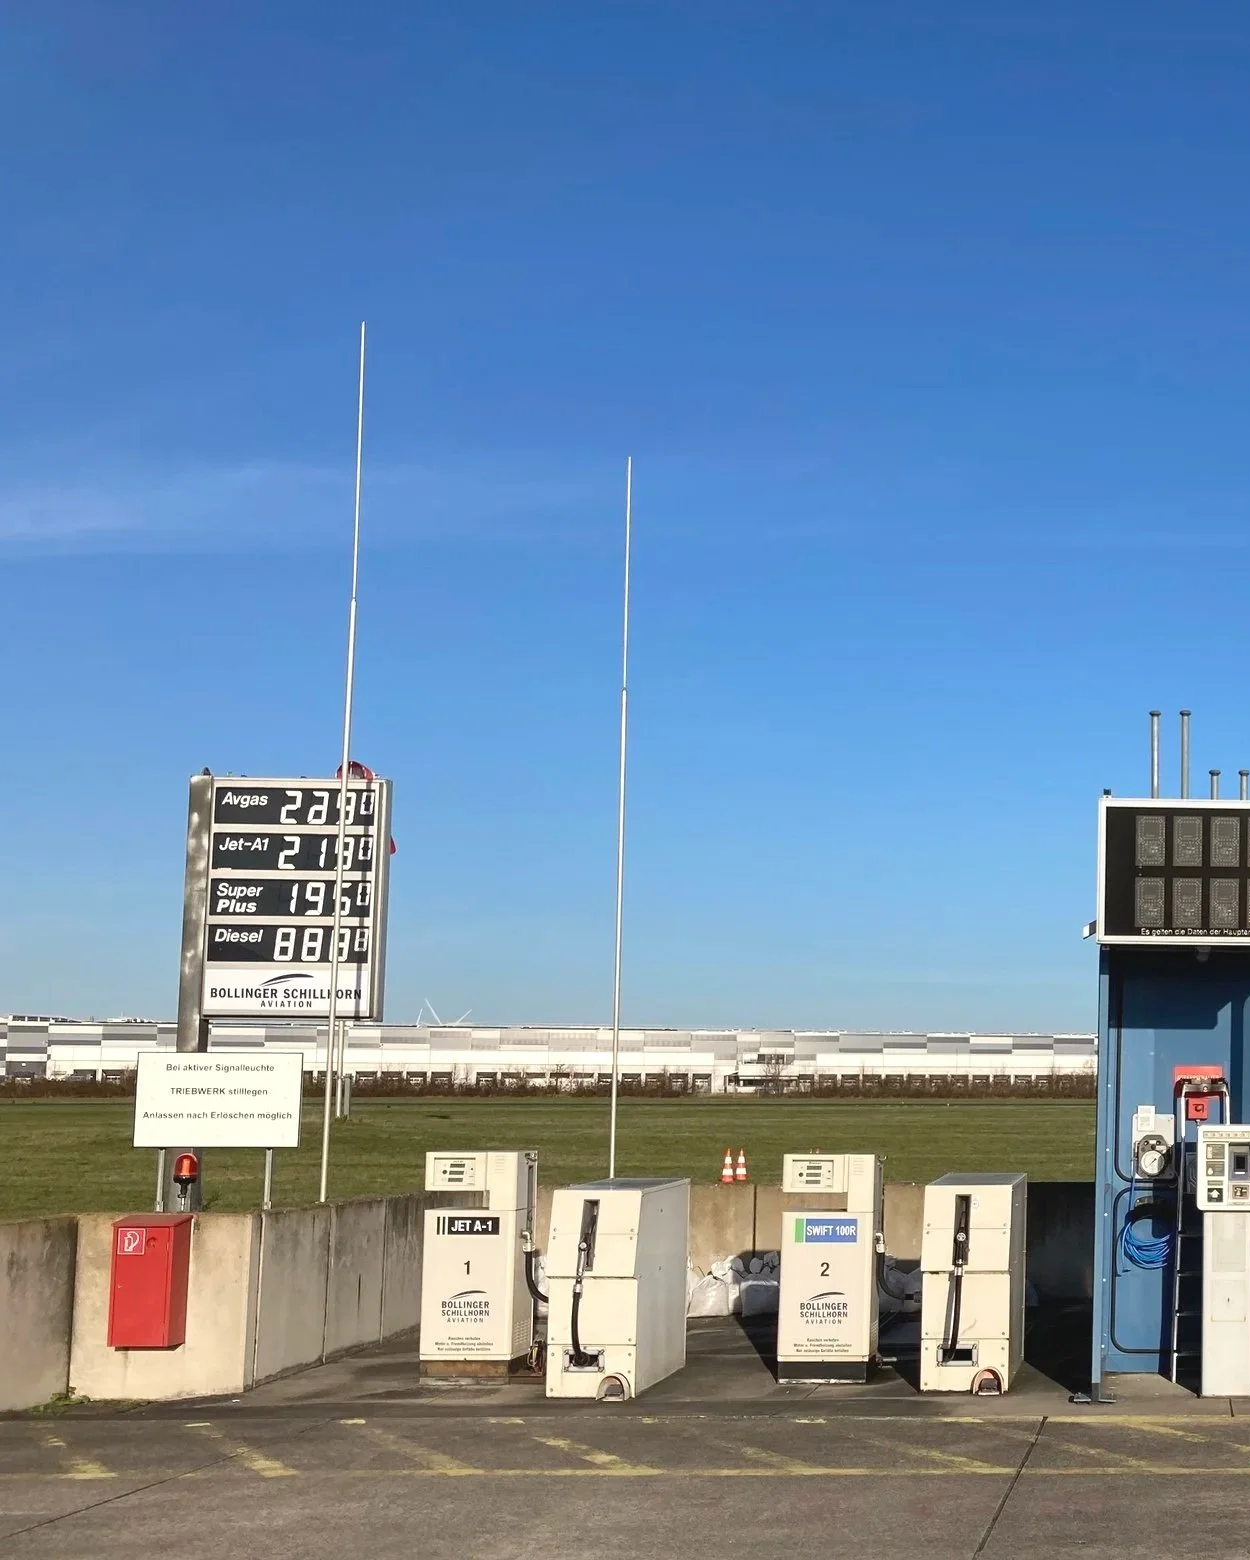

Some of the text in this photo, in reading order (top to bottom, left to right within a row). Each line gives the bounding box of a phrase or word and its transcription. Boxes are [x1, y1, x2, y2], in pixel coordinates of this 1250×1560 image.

[222, 792, 269, 808] Avgas
[219, 838, 270, 851] Jet-A1
[216, 882, 264, 898] Super
[216, 899, 258, 913] Plus
[214, 928, 264, 943] Diesel
[1141, 928, 1150, 936] Es
[1187, 928, 1208, 936] Daten
[1209, 928, 1222, 936] der
[210, 987, 362, 1000] BOLLINGER SCHILLHORN
[260, 1000, 312, 1008] AVIATION
[166, 1064, 181, 1072] Bei
[215, 1064, 275, 1073] Signalleuchte
[210, 1111, 254, 1119] Erlöschen
[257, 1111, 292, 1120] möglich
[451, 1220, 493, 1232] JET A-1
[806, 1226, 856, 1236] SWIFT 100R
[464, 1260, 471, 1275] 1
[820, 1262, 830, 1277] 2
[441, 1301, 490, 1309] BOLLINGER
[799, 1302, 848, 1311] BOLLINGER
[441, 1309, 490, 1317] SCHILLHORN
